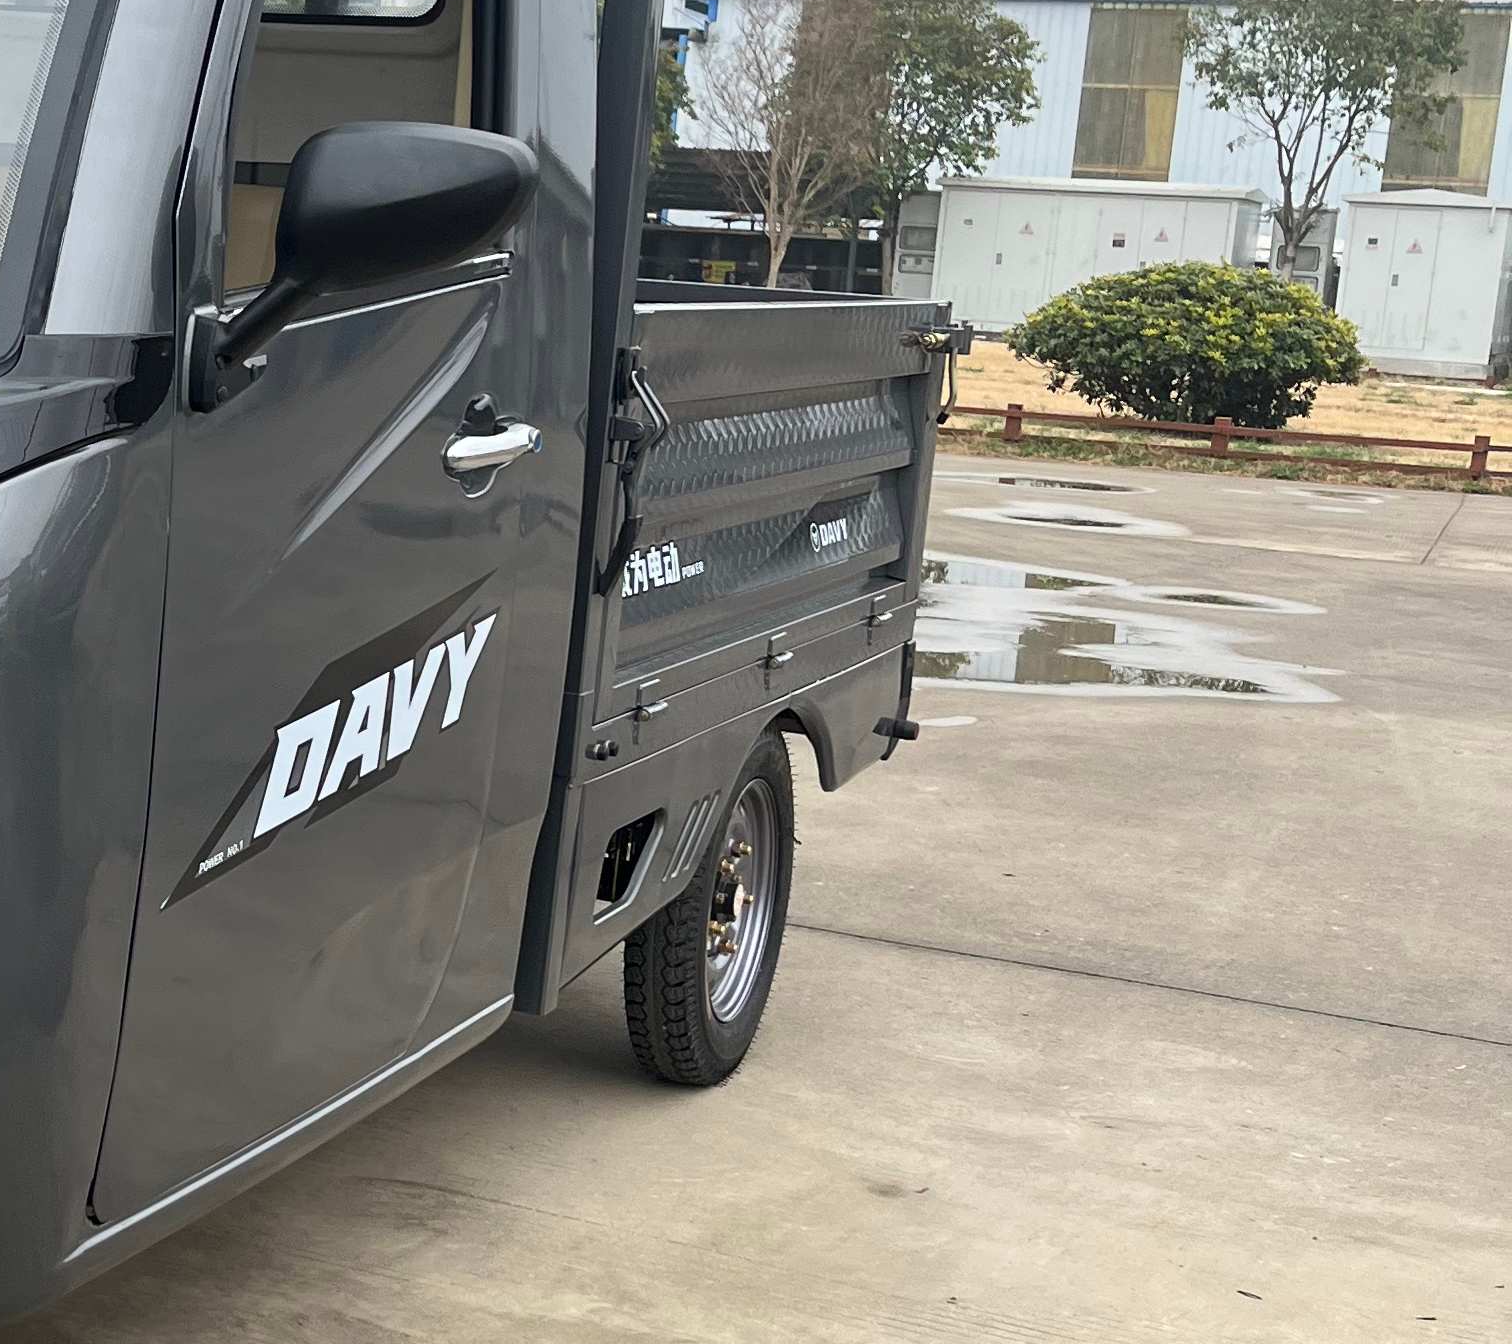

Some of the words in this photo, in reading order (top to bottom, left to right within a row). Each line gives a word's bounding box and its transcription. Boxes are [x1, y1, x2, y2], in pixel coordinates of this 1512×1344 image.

[819, 518, 848, 547] DAVY
[253, 613, 497, 839] DAVY
[198, 851, 224, 875] POWER
